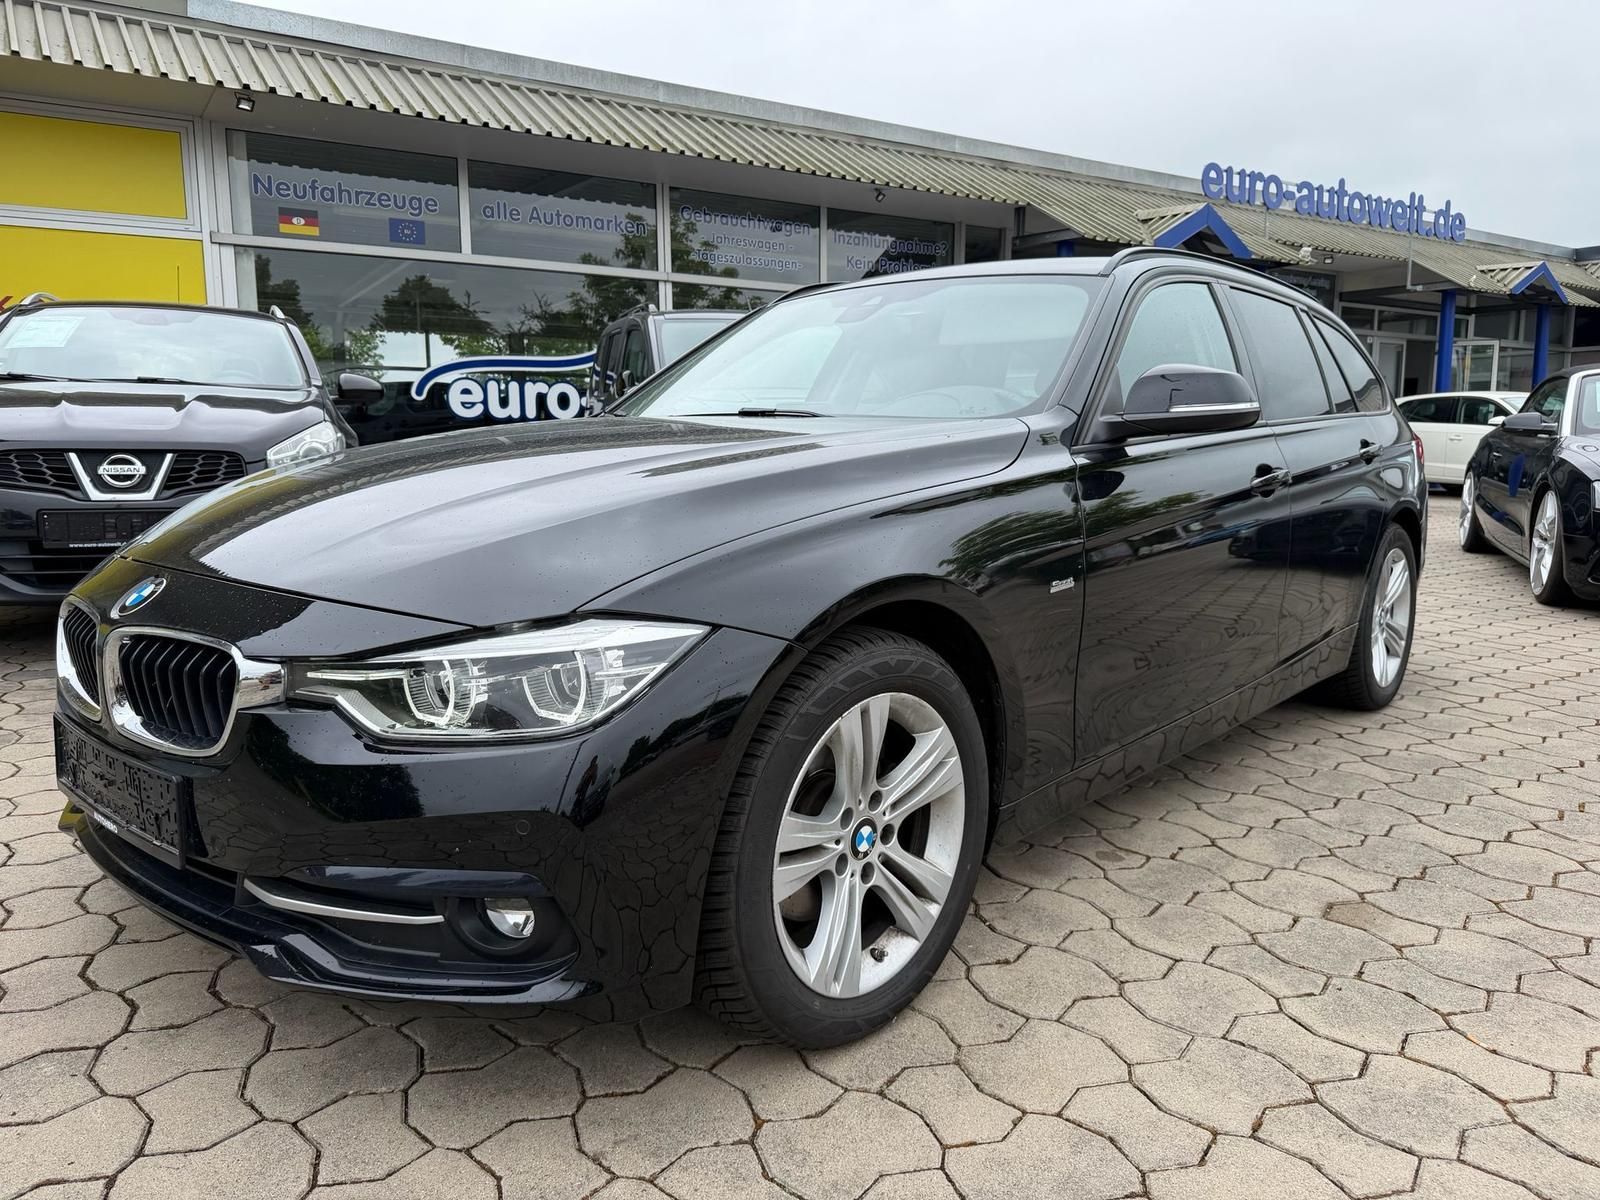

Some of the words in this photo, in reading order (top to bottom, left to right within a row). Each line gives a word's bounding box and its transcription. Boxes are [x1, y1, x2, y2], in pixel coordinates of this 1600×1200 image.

[252, 172, 440, 218] Neufahrzeuge
[1201, 162, 1466, 242] euro-autowelt.de
[482, 200, 521, 222] alle
[528, 206, 648, 236] Automarken
[680, 205, 811, 237] Gebrauchtwagen
[710, 232, 785, 253] Jahreswagen
[833, 230, 949, 257] Inzahlungnahme?
[846, 256, 876, 273] Kein
[448, 377, 588, 420] euro
